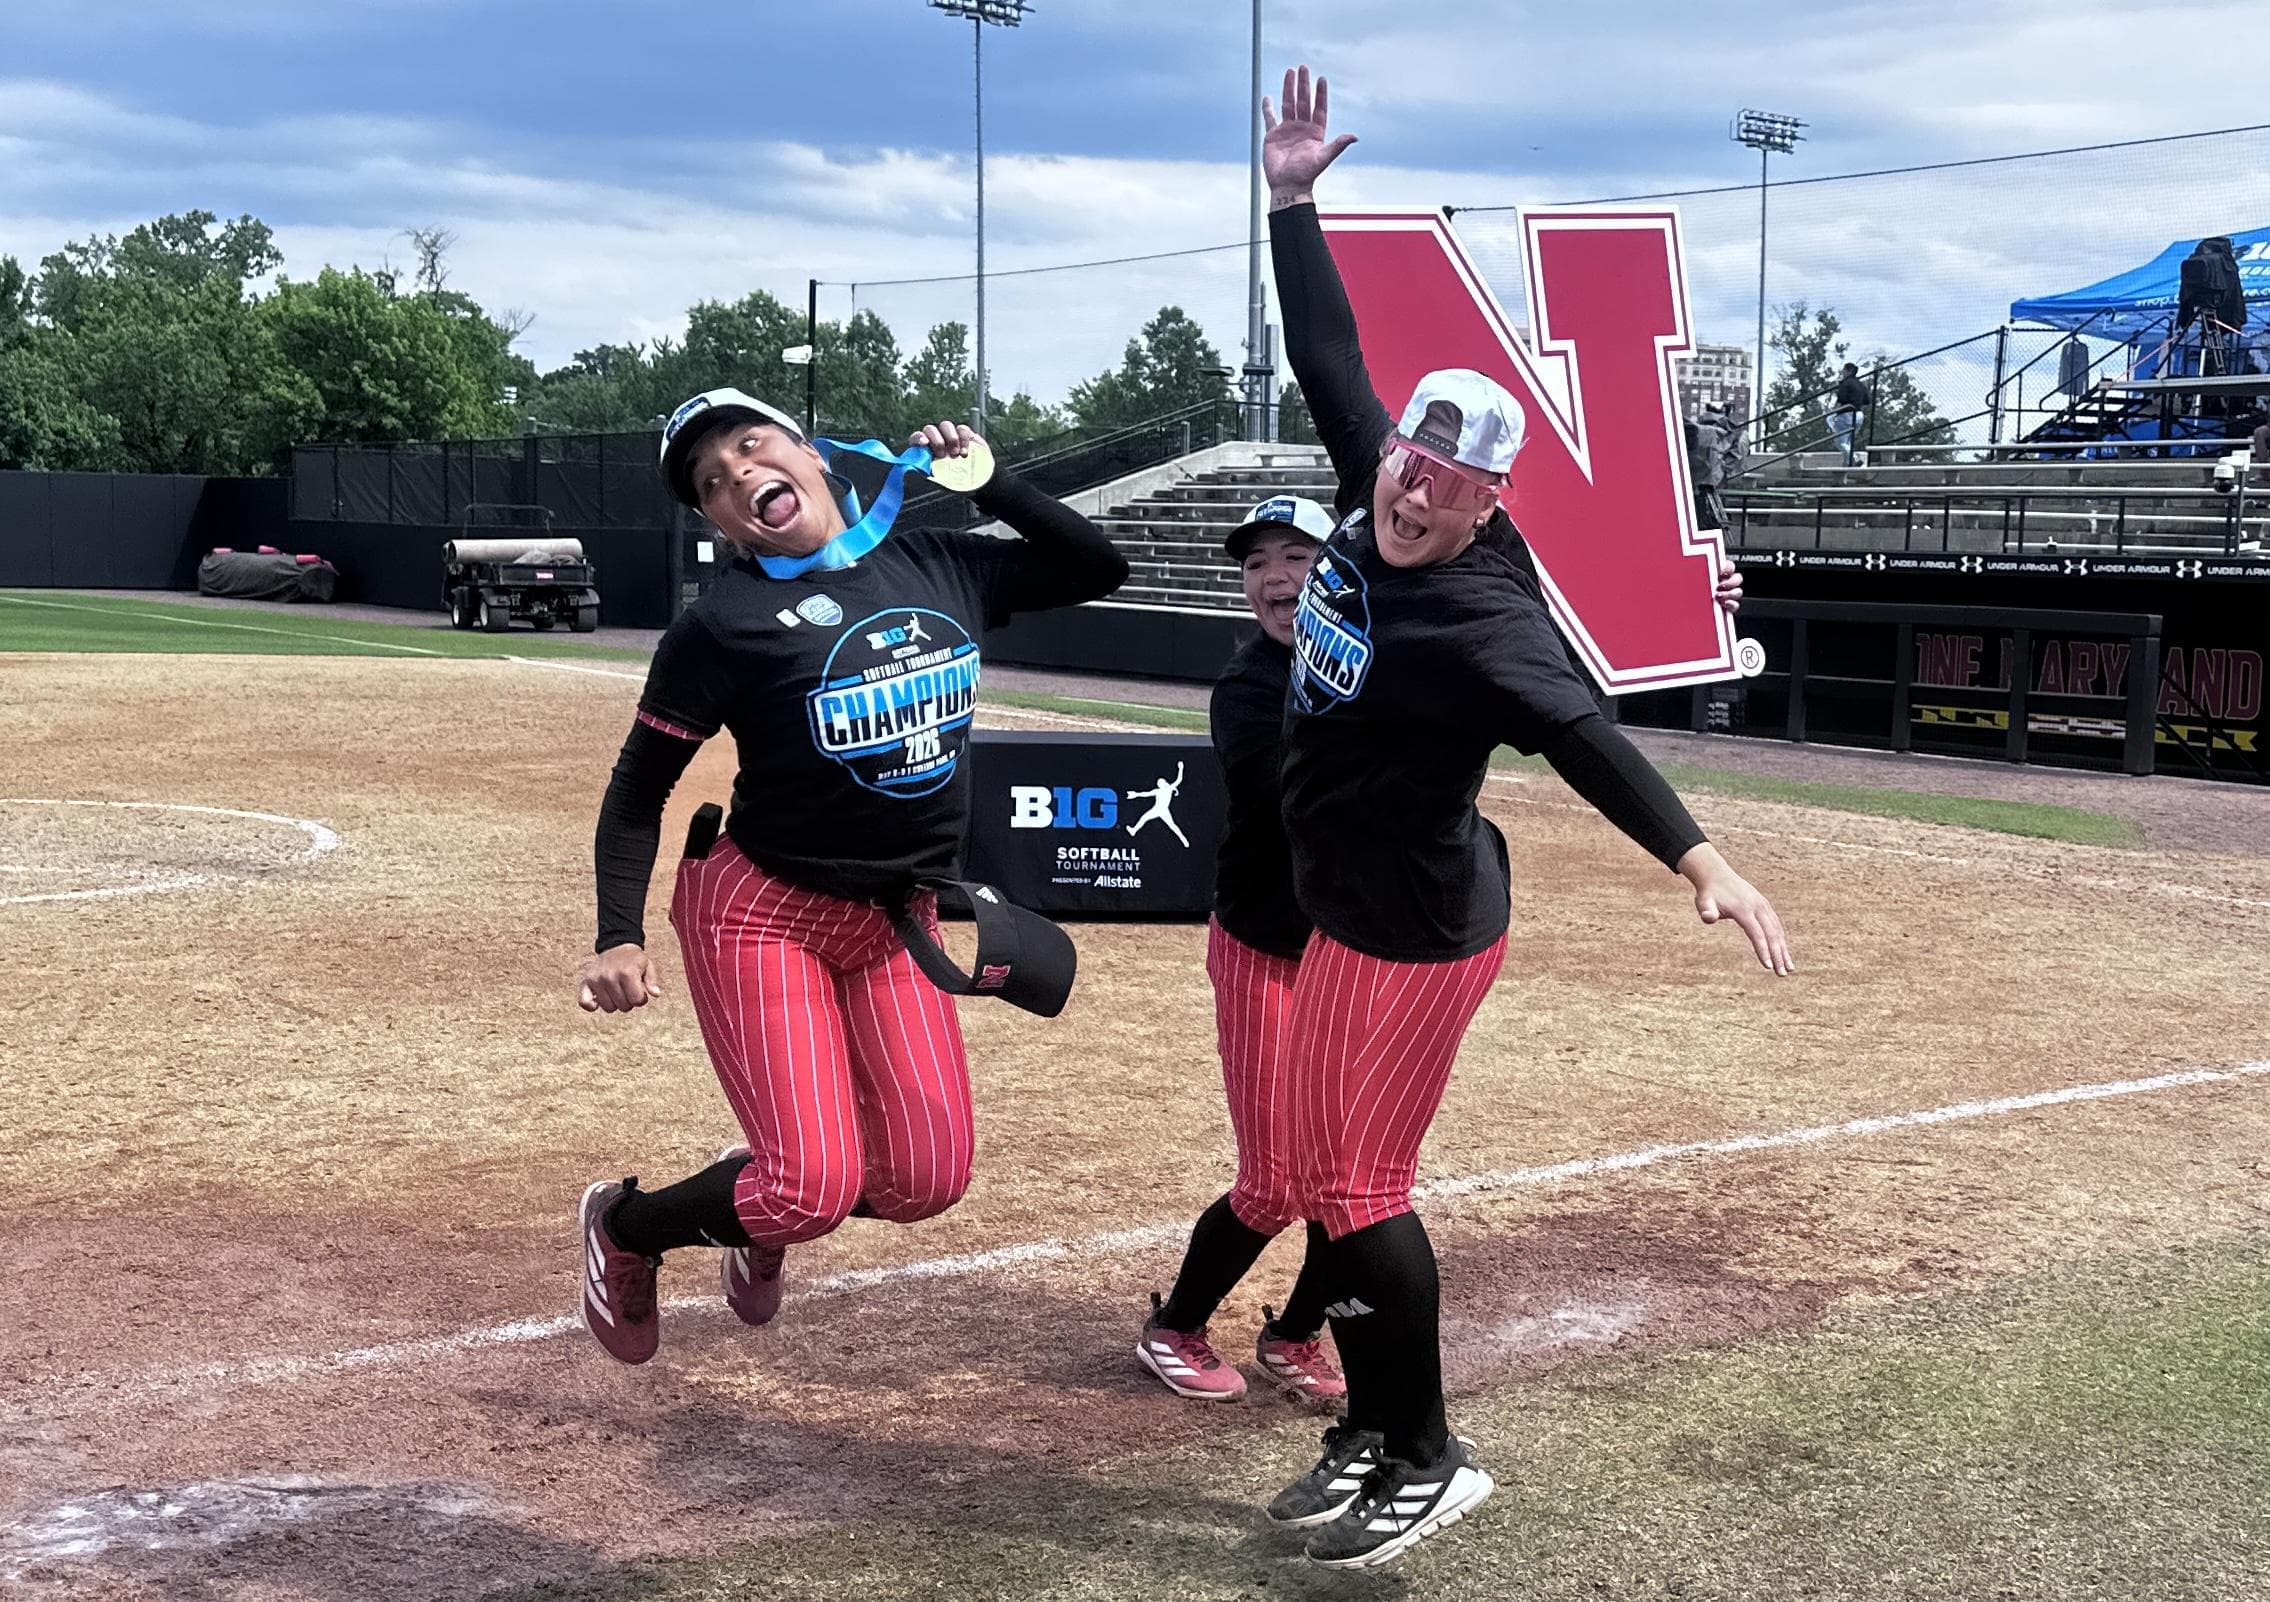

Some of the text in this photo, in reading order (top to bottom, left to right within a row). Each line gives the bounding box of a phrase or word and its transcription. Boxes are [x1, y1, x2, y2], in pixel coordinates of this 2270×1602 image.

[1316, 205, 1743, 696] N
[1827, 557, 1862, 566] ARMOUR
[1889, 559, 1918, 568] UNDER
[1919, 560, 1956, 569] ARMOUR
[1987, 561, 2018, 570] UNDER
[2018, 562, 2059, 572] ARMOUR
[2093, 563, 2126, 573] UNDER
[2127, 564, 2170, 574] ARMOUR
[2207, 566, 2243, 575] UNDER
[2244, 567, 2270, 577] ARM
[2000, 638, 2263, 721] ARYAND
[1057, 847, 1140, 861] SOFTBALL
[1055, 860, 1141, 871] TOURNAMENT
[1094, 875, 1142, 888] Allstate
